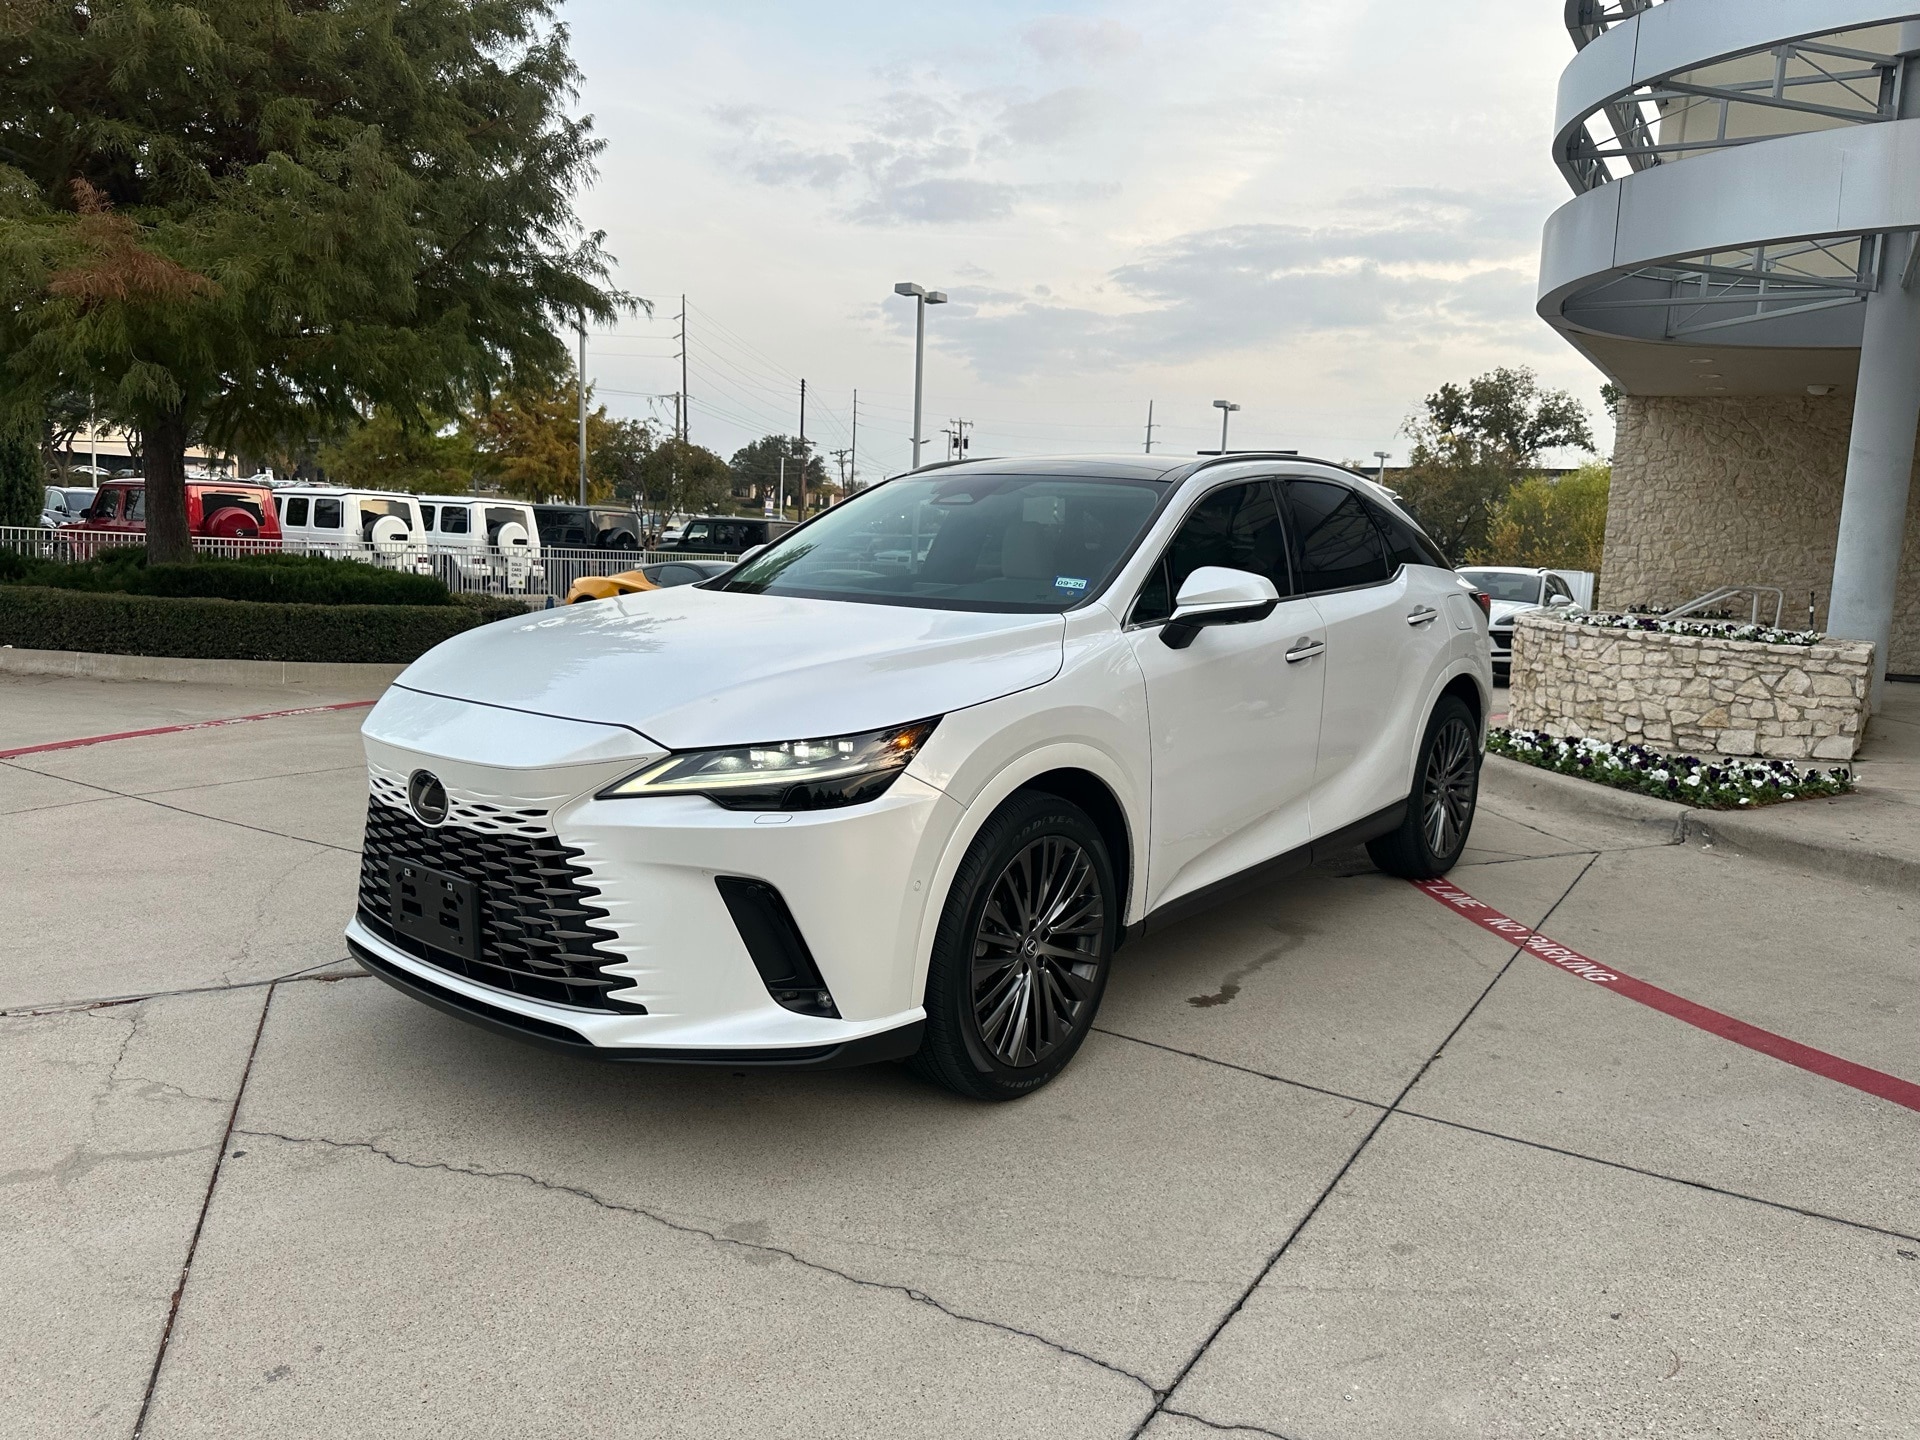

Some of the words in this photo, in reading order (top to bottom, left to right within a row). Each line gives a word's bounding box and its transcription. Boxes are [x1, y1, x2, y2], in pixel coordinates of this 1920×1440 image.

[1426, 886, 1487, 909] LANE
[1484, 918, 1527, 932] NO
[1514, 934, 1618, 982] PARKING
